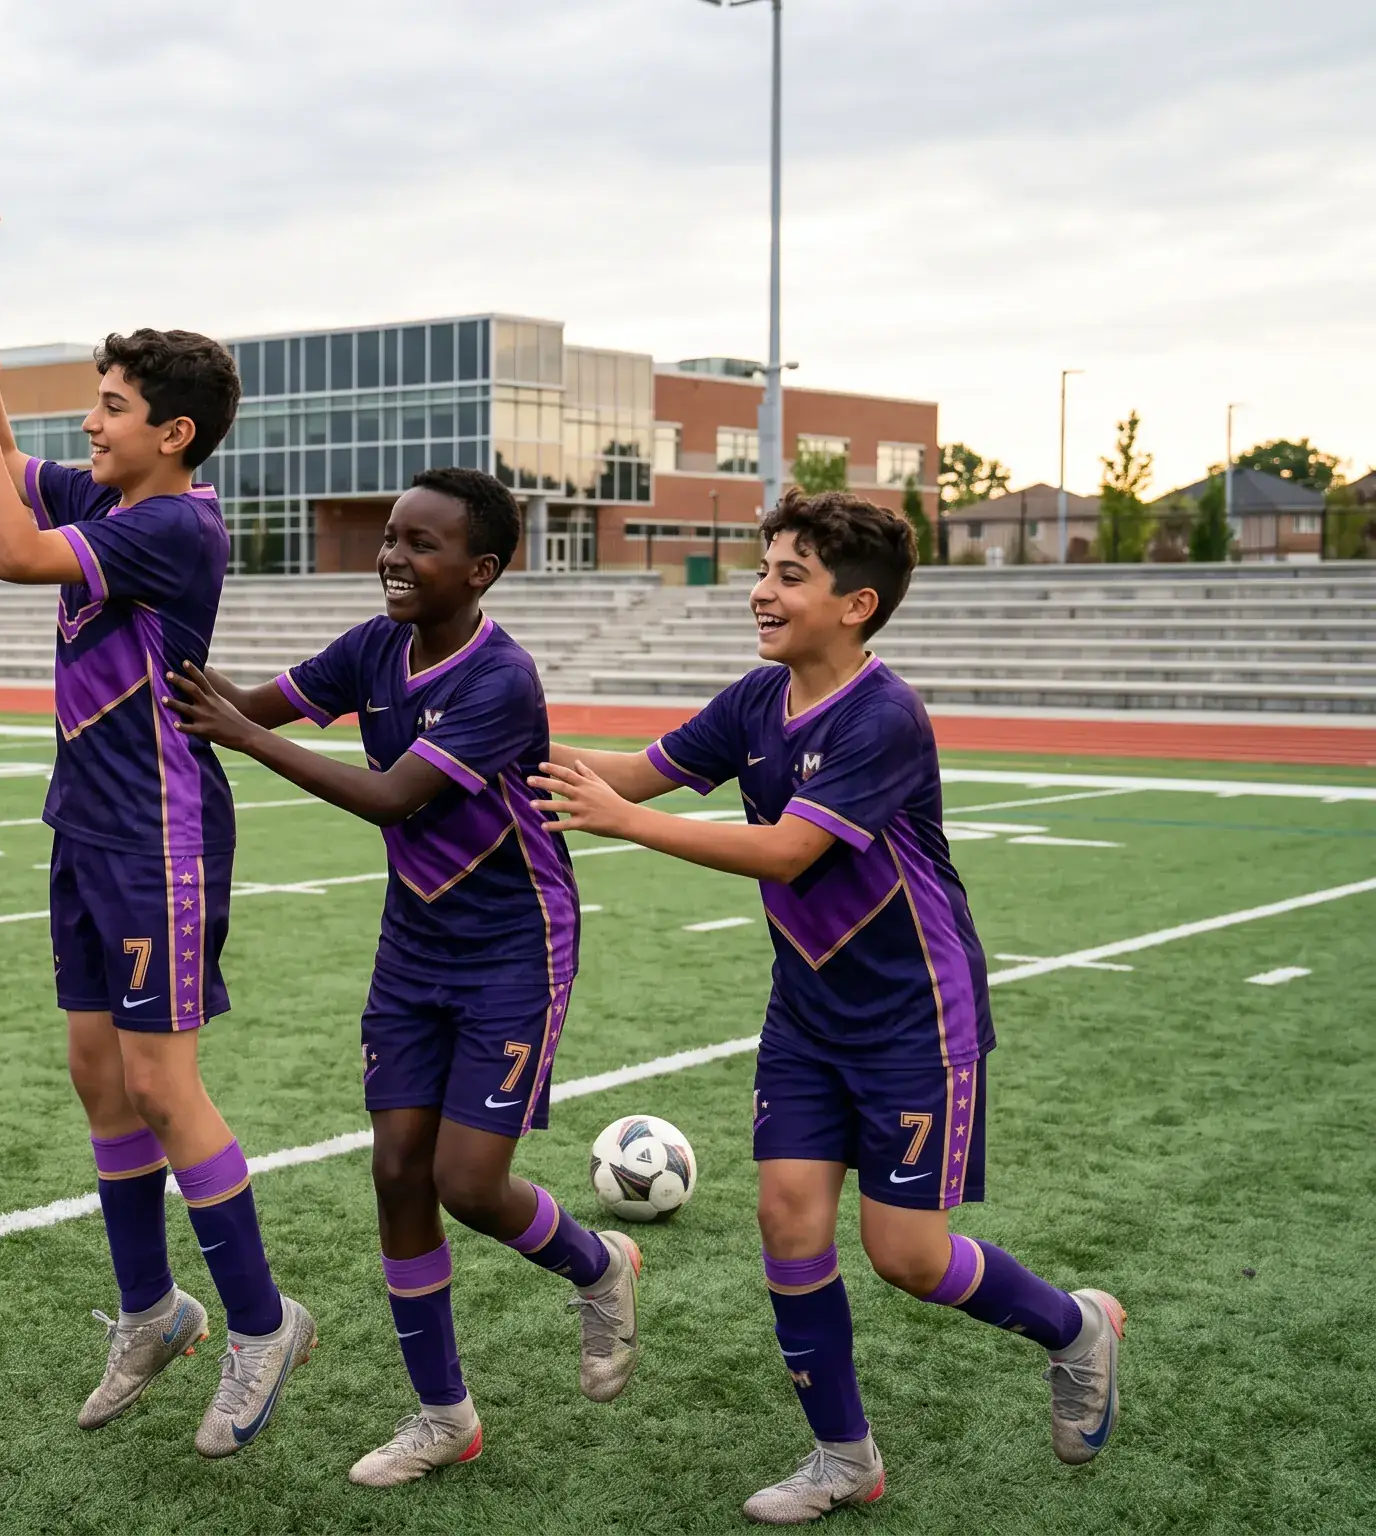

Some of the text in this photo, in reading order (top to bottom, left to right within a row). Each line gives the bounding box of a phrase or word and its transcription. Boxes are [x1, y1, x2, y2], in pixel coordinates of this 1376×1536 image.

[803, 752, 823, 781] M
[123, 937, 152, 990] 7
[500, 1040, 531, 1092] 7
[900, 1111, 933, 1165] 7
